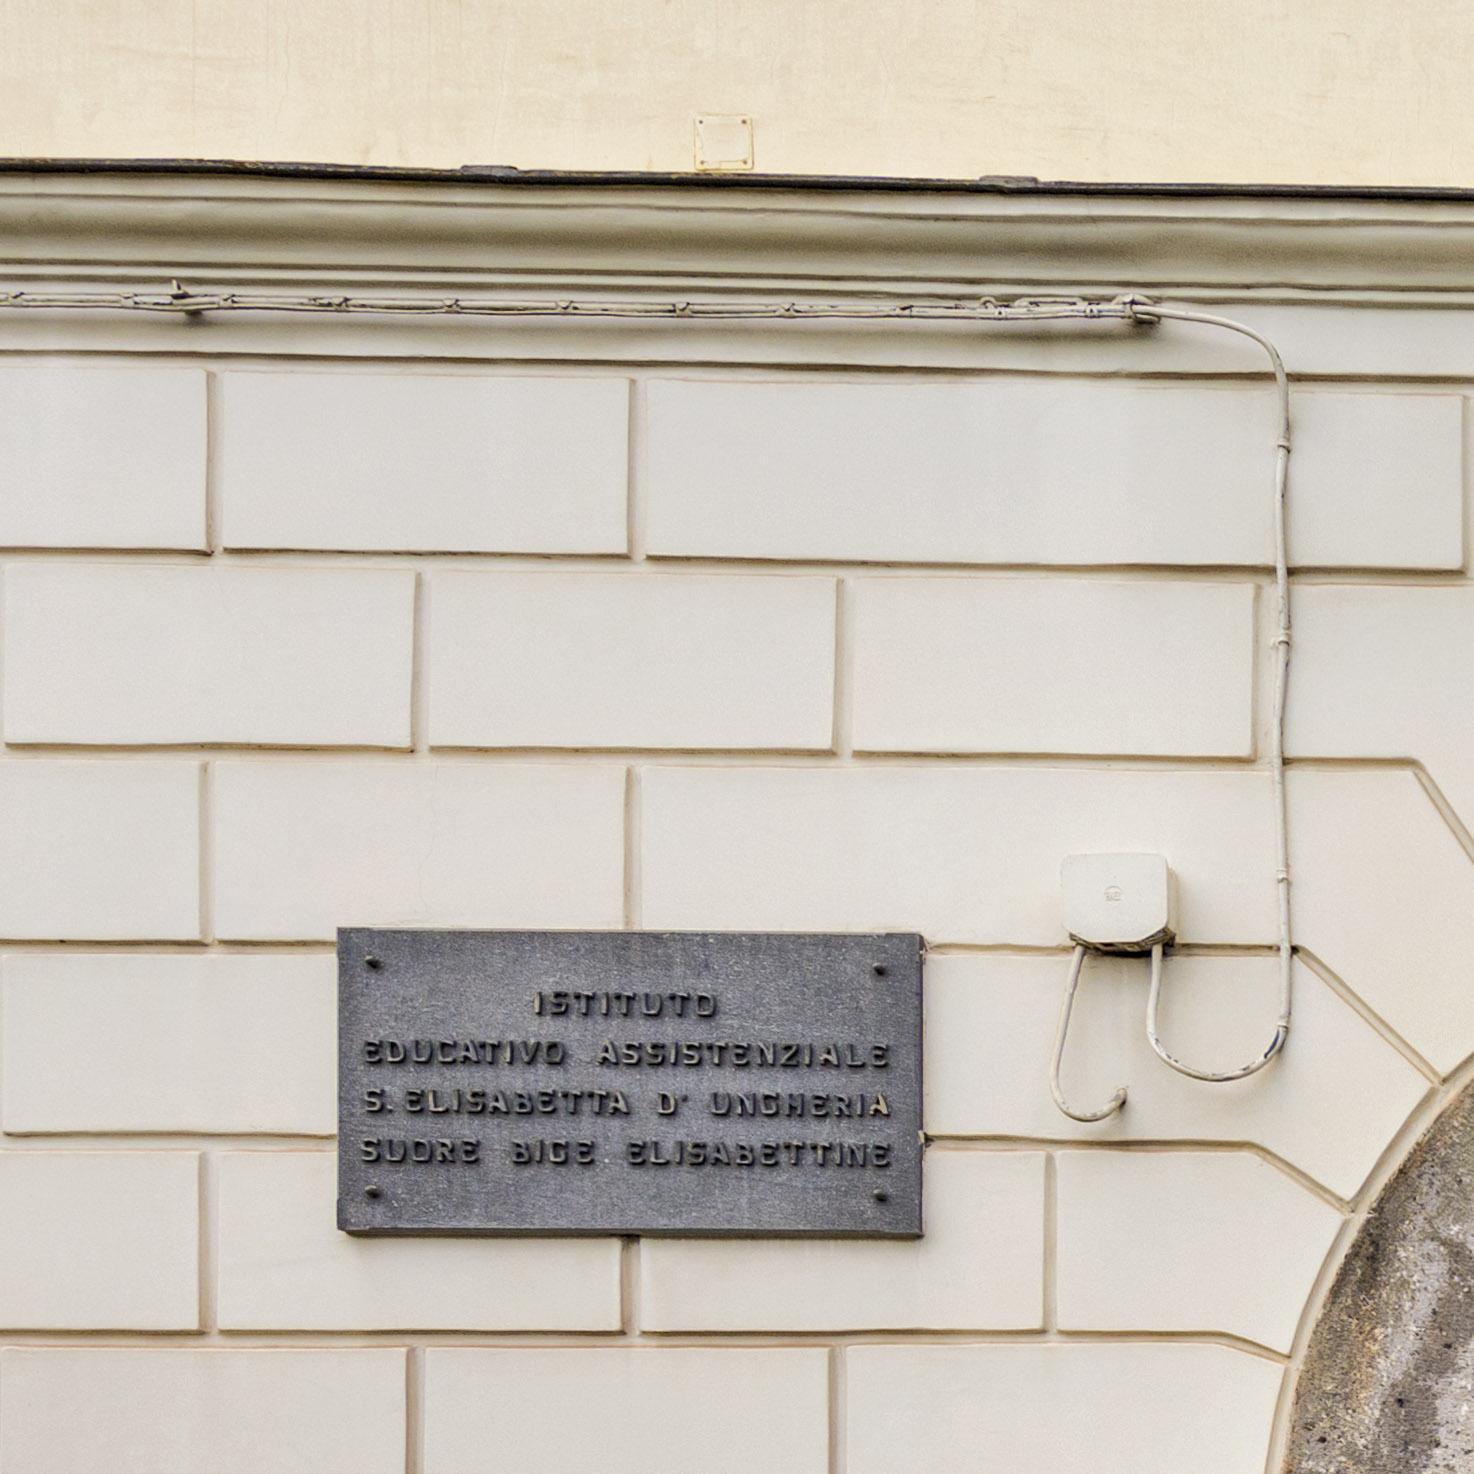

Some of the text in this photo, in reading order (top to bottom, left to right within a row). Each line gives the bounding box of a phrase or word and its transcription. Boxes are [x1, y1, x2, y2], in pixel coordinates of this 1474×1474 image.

[532, 990, 717, 1018] ISTITUTO
[364, 1040, 890, 1068] EDUCATIVO ASSISTENZIALE
[405, 1088, 631, 1115] ELISABETTA
[655, 1091, 689, 1117] D'
[709, 1092, 891, 1118] UNGHERIA
[360, 1138, 480, 1164] SUORE
[626, 1141, 893, 1169] ELISABETTINE
